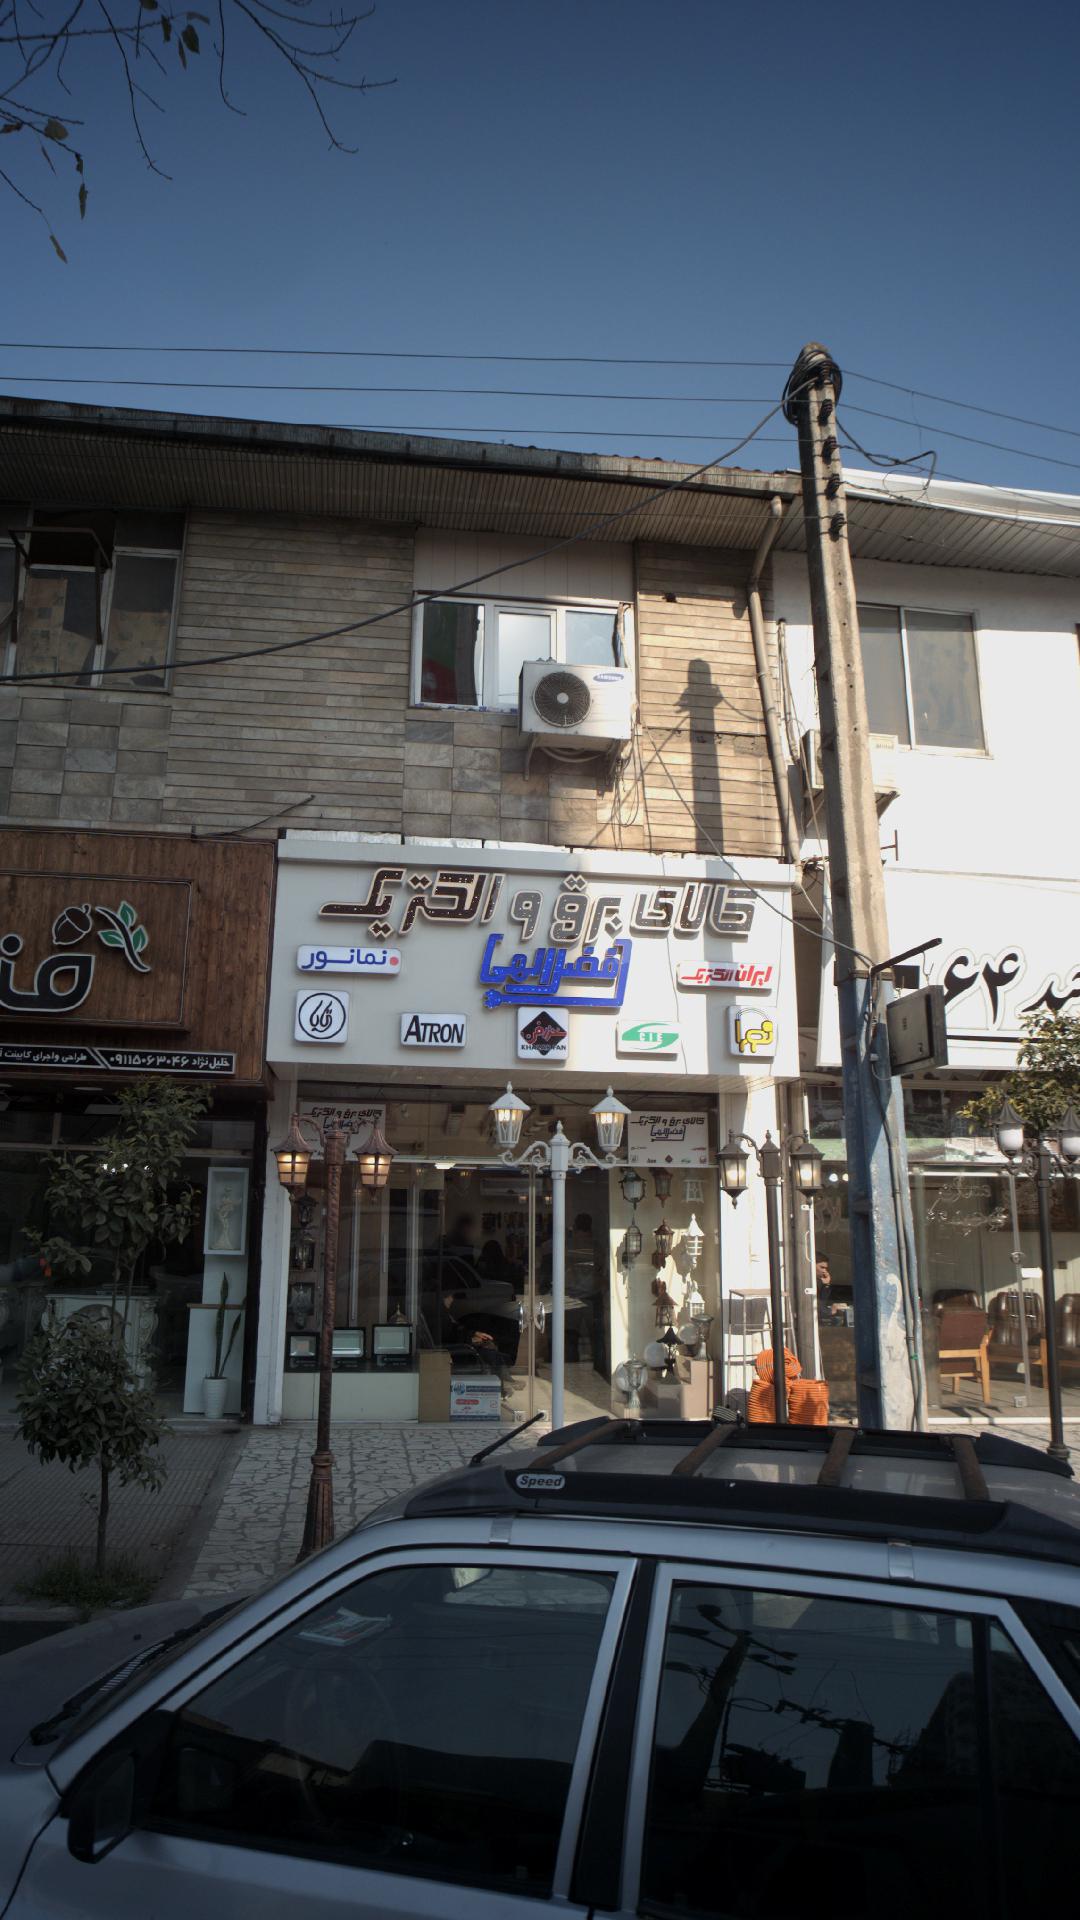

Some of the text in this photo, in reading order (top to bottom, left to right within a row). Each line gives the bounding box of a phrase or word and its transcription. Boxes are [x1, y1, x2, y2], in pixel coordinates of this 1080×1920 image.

[318, 867, 758, 944] کالای برق و الکتریک
[301, 949, 388, 970] نمانور
[735, 964, 773, 987] ایران
[403, 1014, 465, 1044] ATRON
[520, 1475, 563, 1487] Speed
